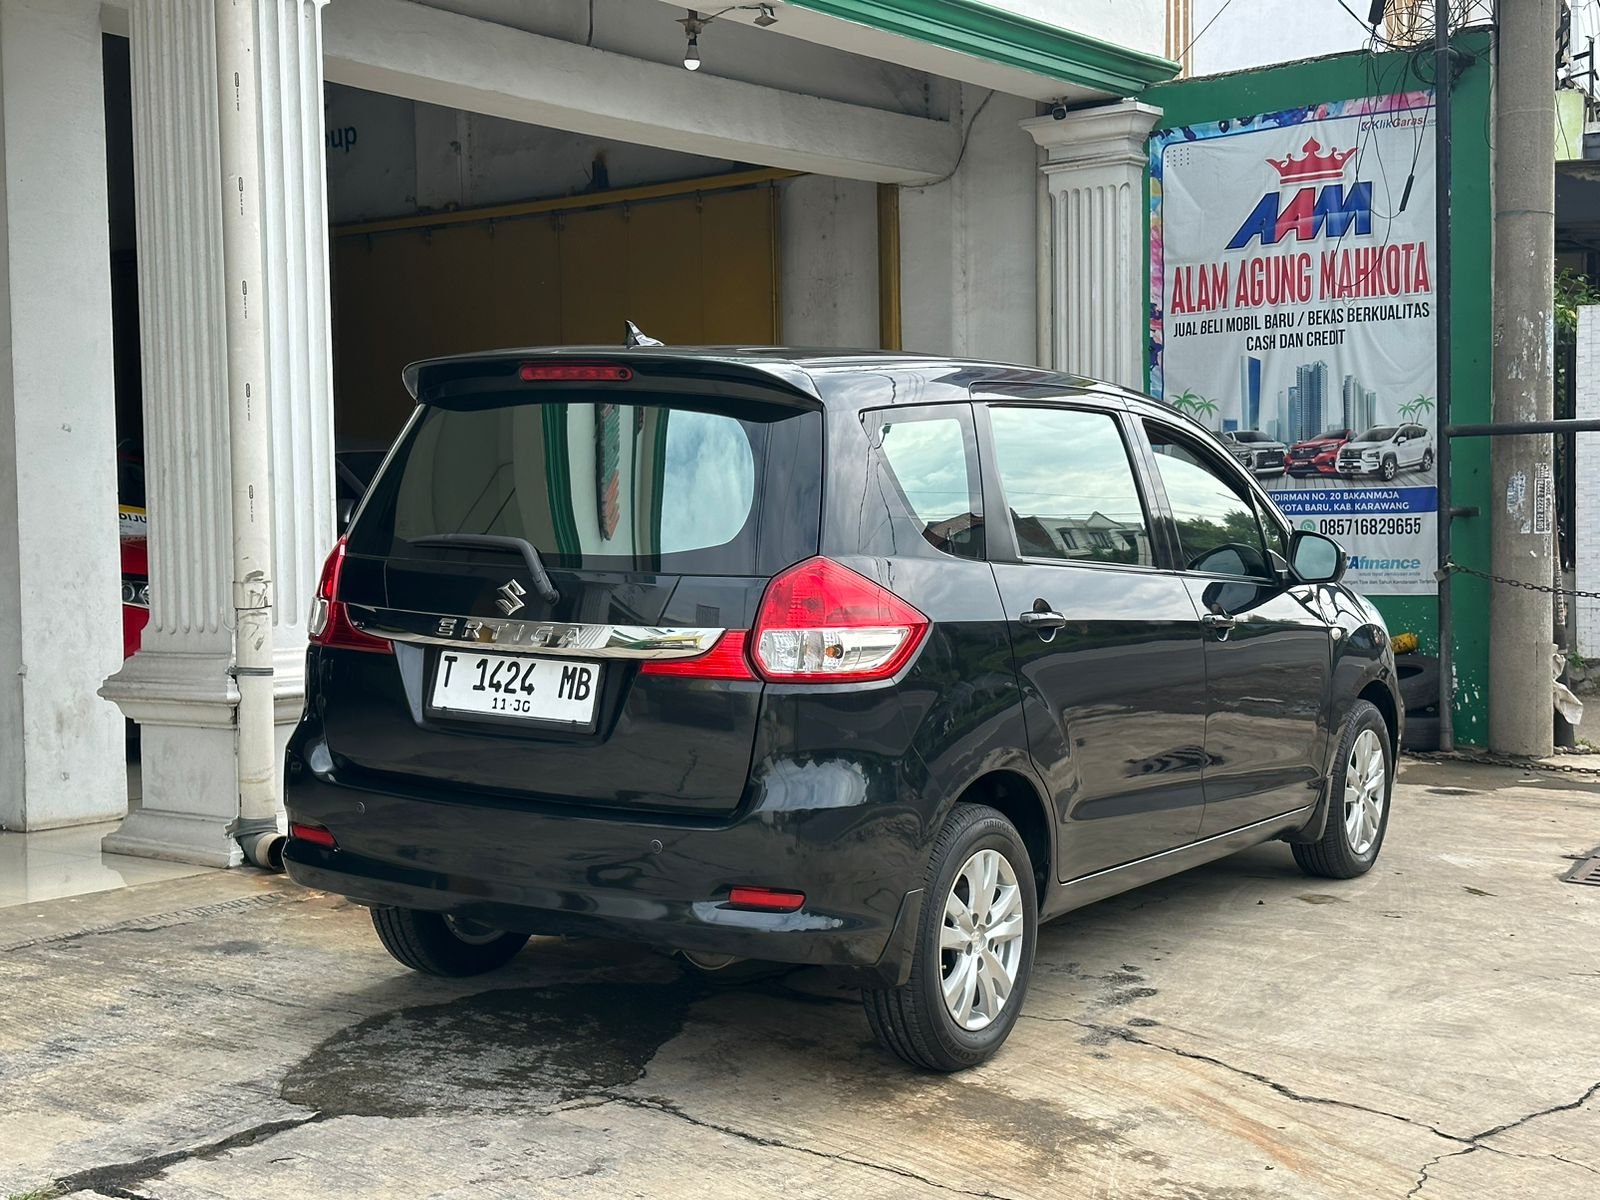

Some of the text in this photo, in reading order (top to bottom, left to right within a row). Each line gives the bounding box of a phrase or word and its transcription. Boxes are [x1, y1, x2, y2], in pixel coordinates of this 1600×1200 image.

[1372, 116, 1426, 130] KlikGaras
[325, 126, 357, 152] up
[1225, 180, 1373, 250] AAM
[1170, 241, 1431, 315] ALAM AGUNG MAHKOTA
[1173, 321, 1198, 338] JUAL
[1200, 318, 1223, 335] BELI
[1226, 315, 1261, 333] MOBIL
[1264, 312, 1294, 330] BARU
[1308, 308, 1344, 326] BEKAS
[1347, 302, 1430, 323] BERKUALITAS
[1246, 329, 1346, 351] CASH DAN CREDIT
[1304, 502, 1332, 512] BARU,
[1354, 501, 1410, 511] KARAWANG
[1312, 492, 1328, 501] NO.
[1330, 492, 1341, 500] 20
[1343, 490, 1400, 500] BAKANMAJA
[1319, 517, 1422, 536] 085716829655
[1347, 555, 1421, 569] Afinance
[436, 617, 581, 645] ERTIGA
[444, 655, 593, 701] T 1424 MB
